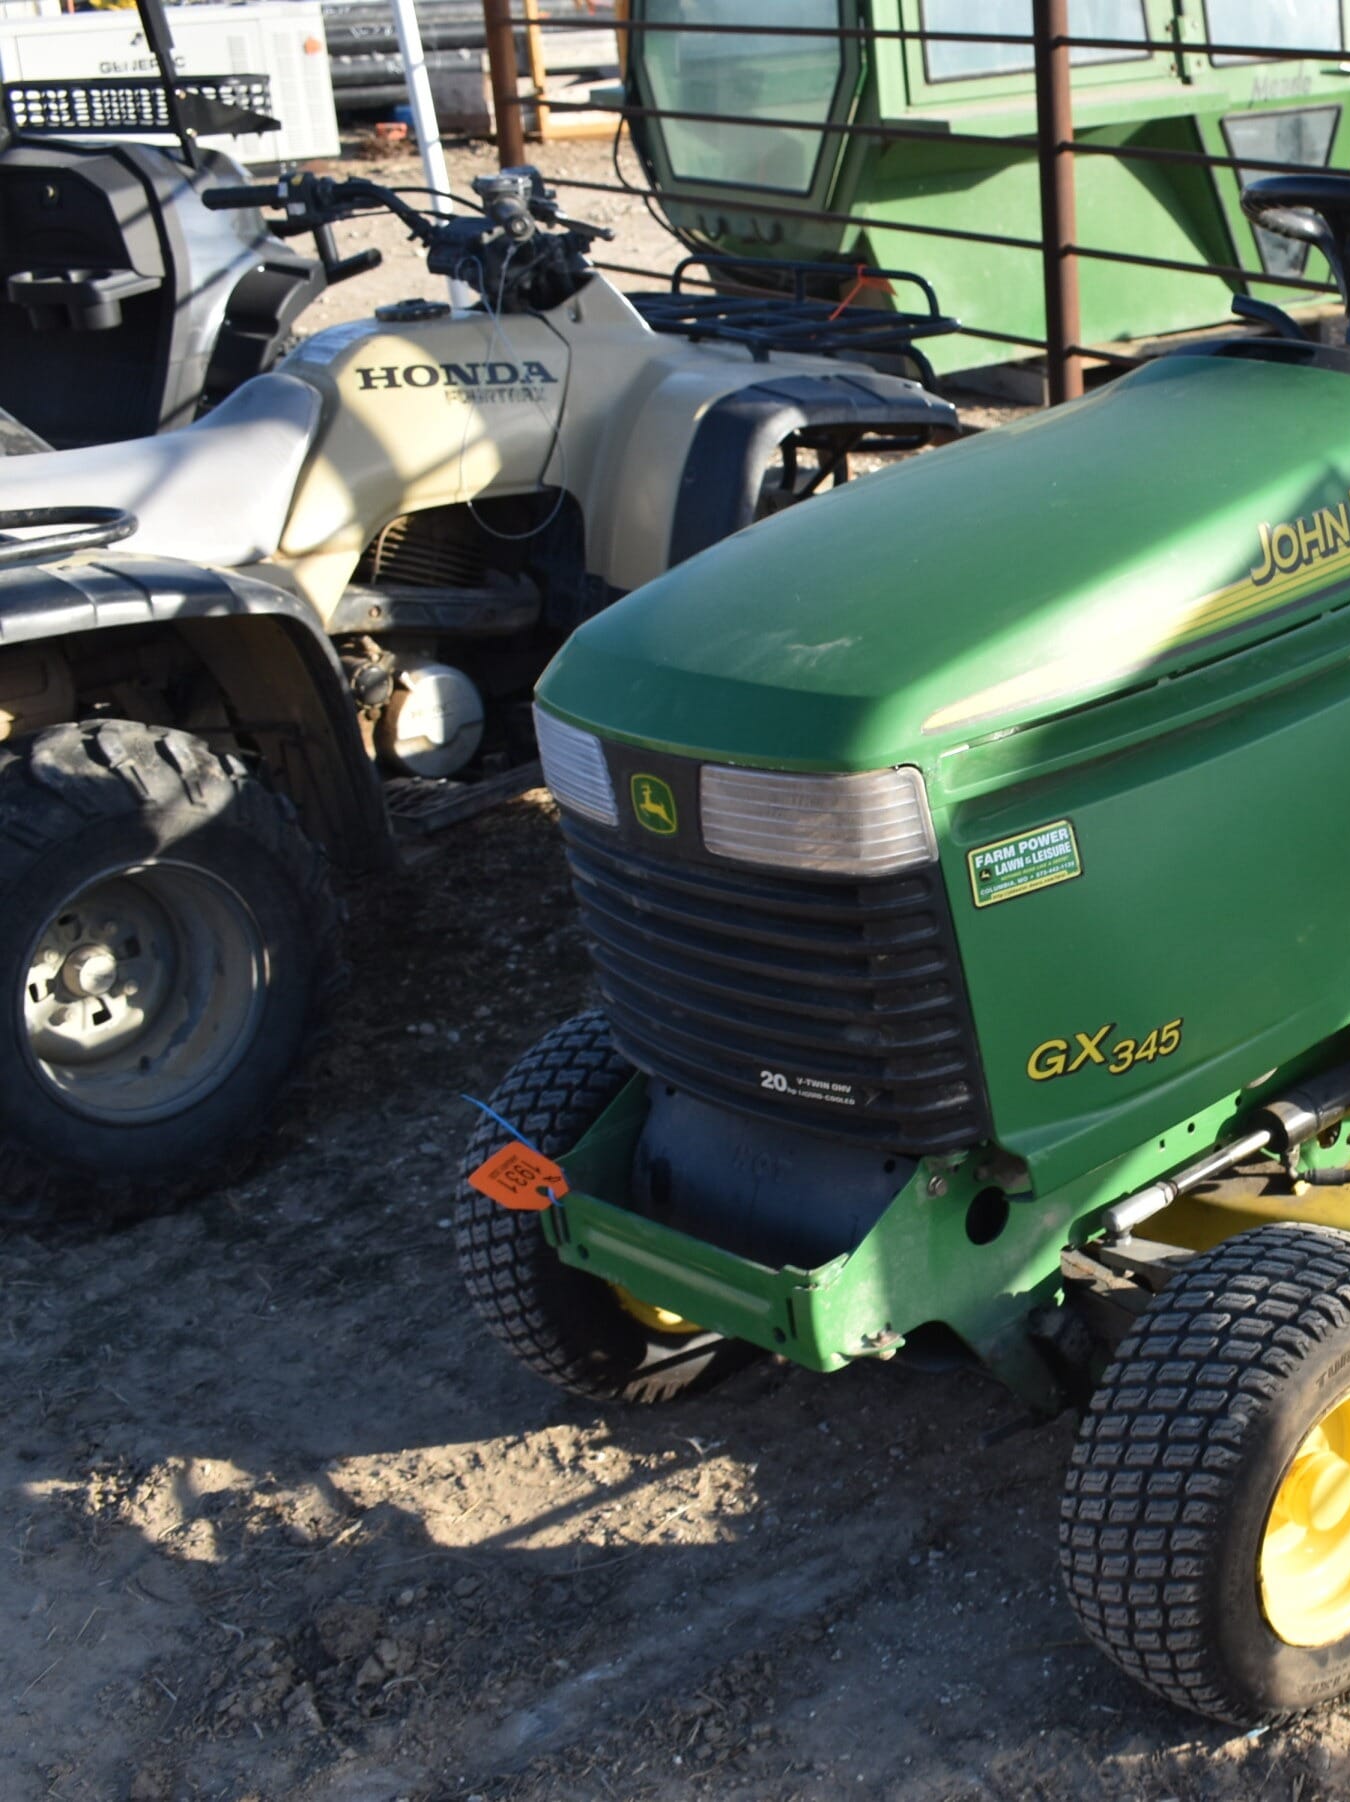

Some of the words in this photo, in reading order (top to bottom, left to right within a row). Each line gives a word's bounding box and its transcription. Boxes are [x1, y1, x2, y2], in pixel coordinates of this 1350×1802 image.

[99, 56, 186, 74] GENERC
[355, 361, 558, 390] HONDA
[974, 845, 1016, 869] FARM
[1018, 827, 1070, 854] POWER
[994, 856, 1025, 876] LAWN
[1031, 841, 1072, 864] LEISURE
